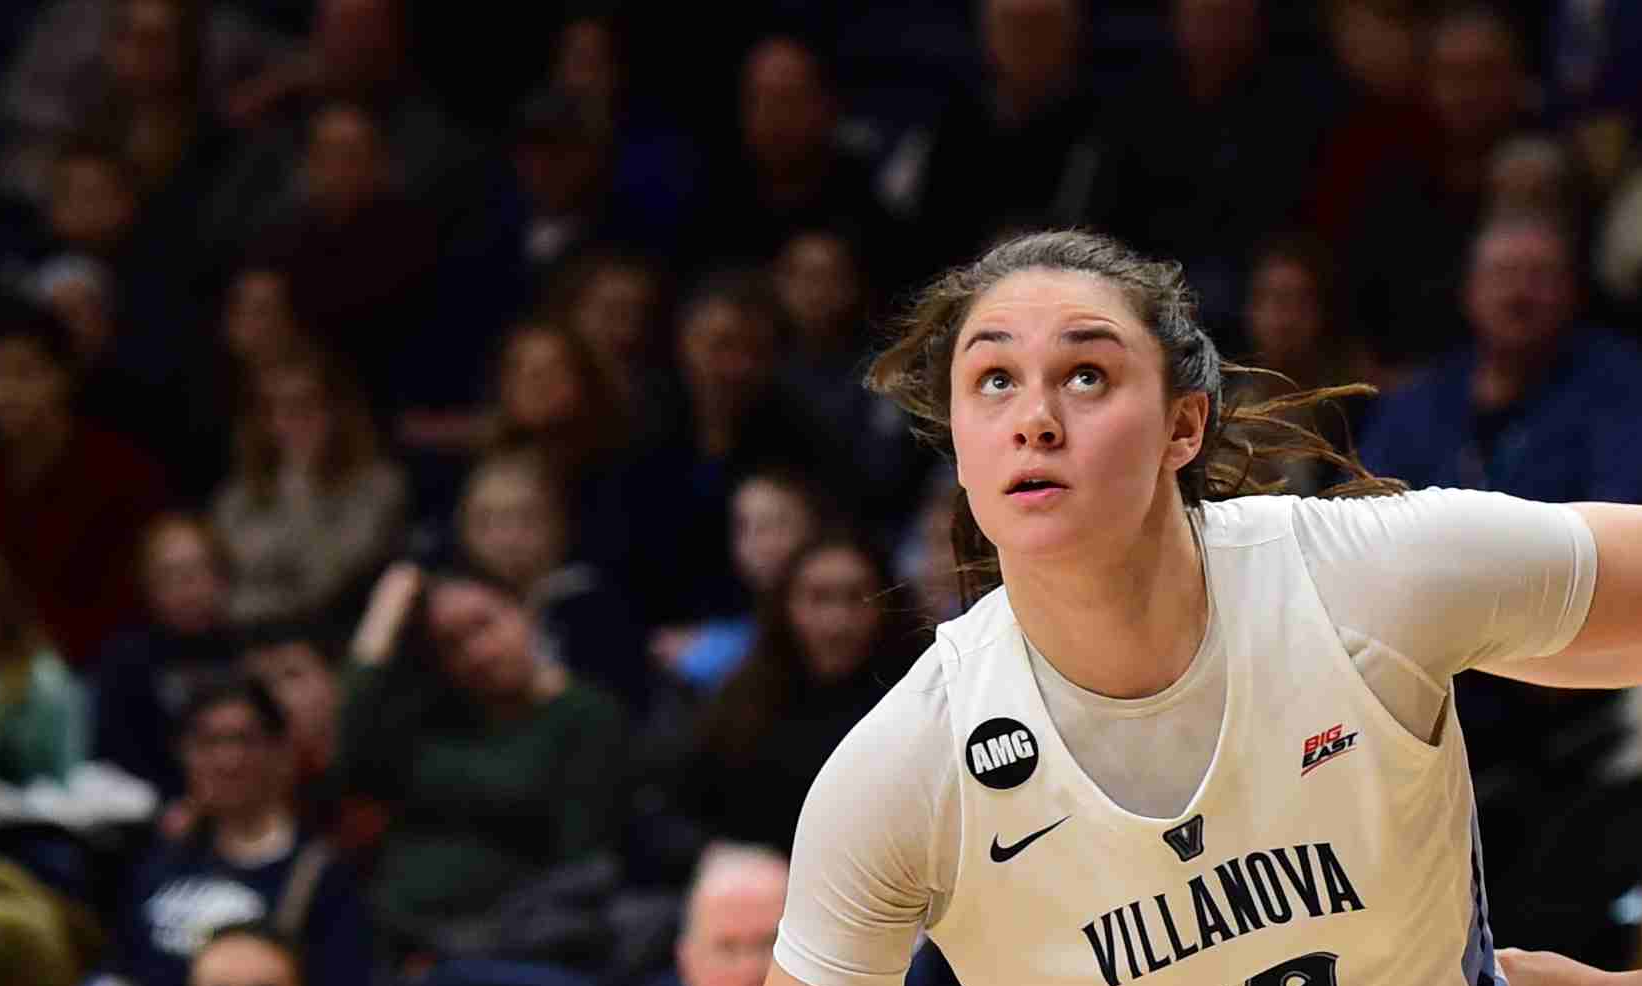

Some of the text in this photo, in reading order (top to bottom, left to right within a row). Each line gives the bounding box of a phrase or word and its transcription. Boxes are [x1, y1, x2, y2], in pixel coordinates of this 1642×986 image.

[971, 730, 1035, 775] AMG
[1302, 732, 1359, 769] EAST
[1304, 723, 1343, 753] BIG
